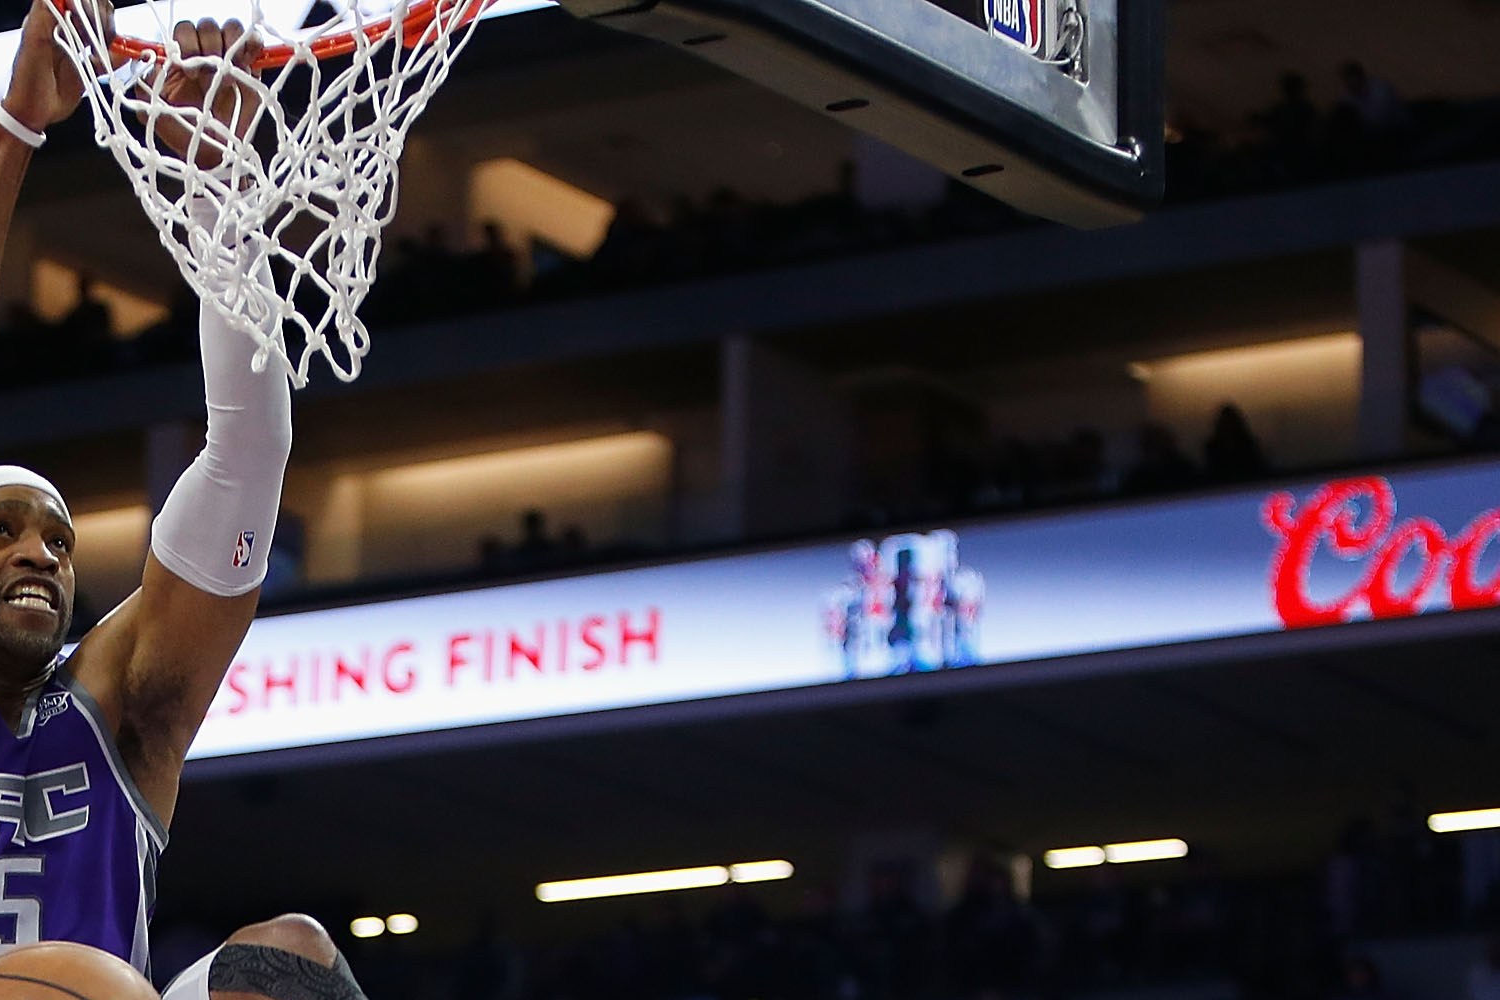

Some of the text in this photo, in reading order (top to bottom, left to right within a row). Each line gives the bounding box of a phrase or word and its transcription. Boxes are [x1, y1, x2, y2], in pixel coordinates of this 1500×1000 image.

[994, 0, 1020, 32] NBA
[202, 606, 662, 720] SHING FINISH
